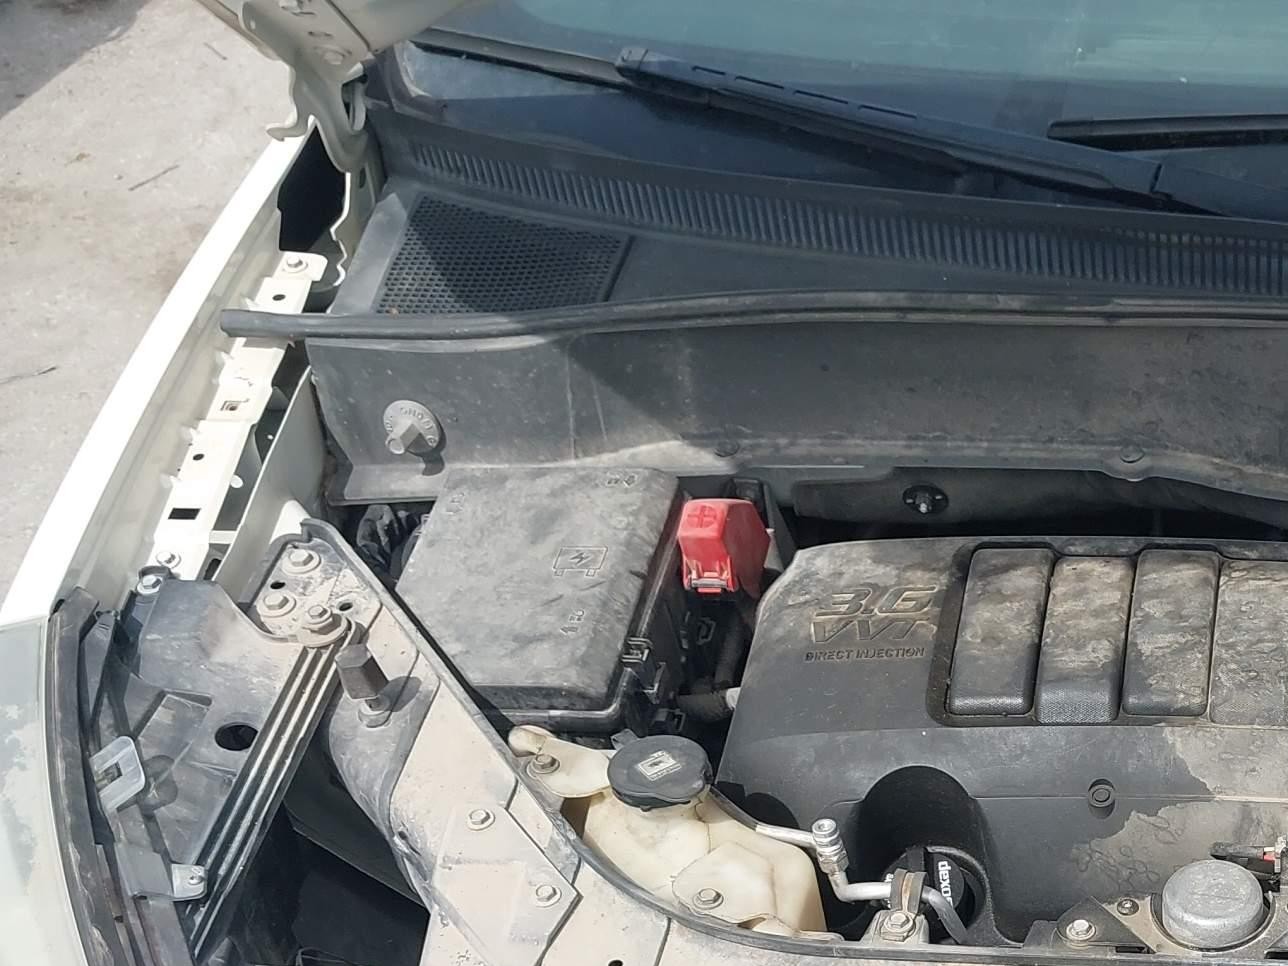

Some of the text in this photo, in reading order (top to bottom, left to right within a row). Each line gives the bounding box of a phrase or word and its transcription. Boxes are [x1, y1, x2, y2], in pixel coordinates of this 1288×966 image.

[814, 585, 938, 616] 3.6
[805, 648, 925, 662] DIRECT INJECTION
